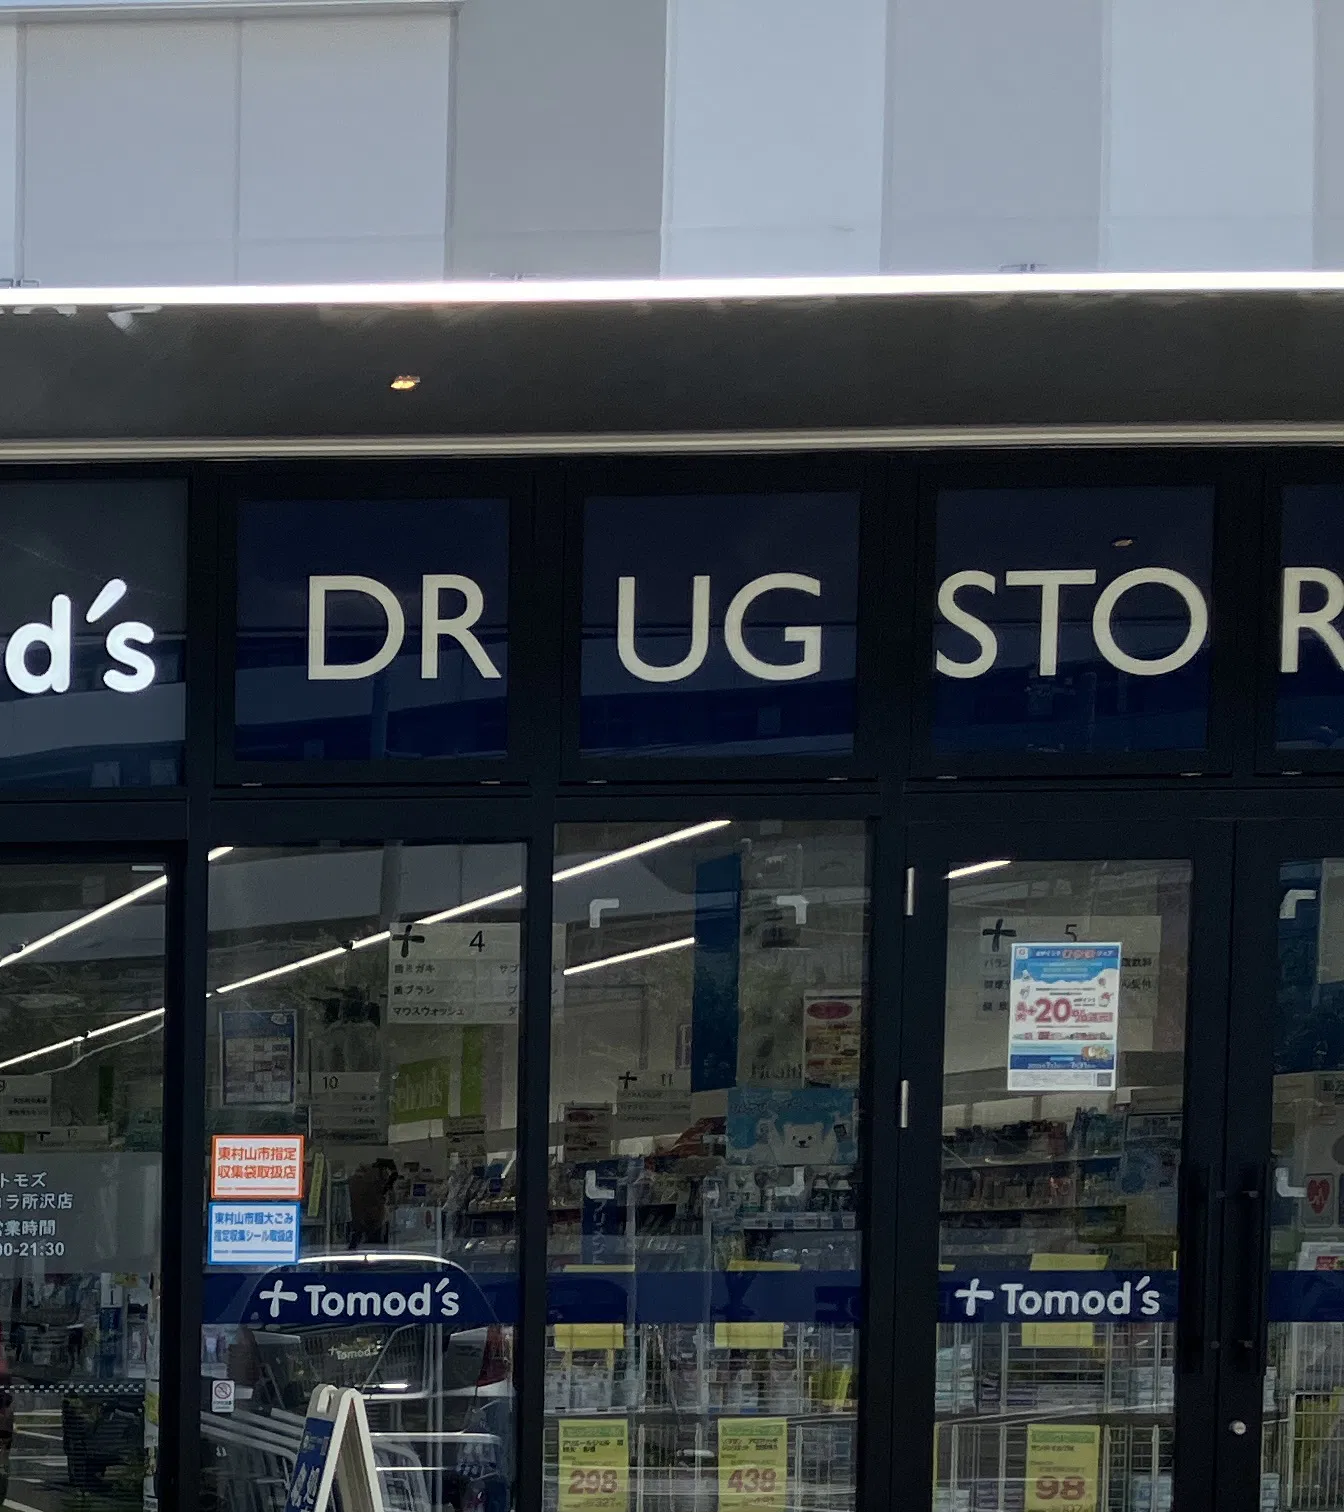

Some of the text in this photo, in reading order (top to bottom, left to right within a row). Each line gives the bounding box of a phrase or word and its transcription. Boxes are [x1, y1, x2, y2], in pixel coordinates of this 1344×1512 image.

[469, 930, 486, 953] 4
[218, 1147, 297, 1161] 東村山市指定
[0, 1171, 48, 1189] トモズ
[303, 1277, 460, 1317] Tomod's
[1000, 1275, 1161, 1316] Tomod's
